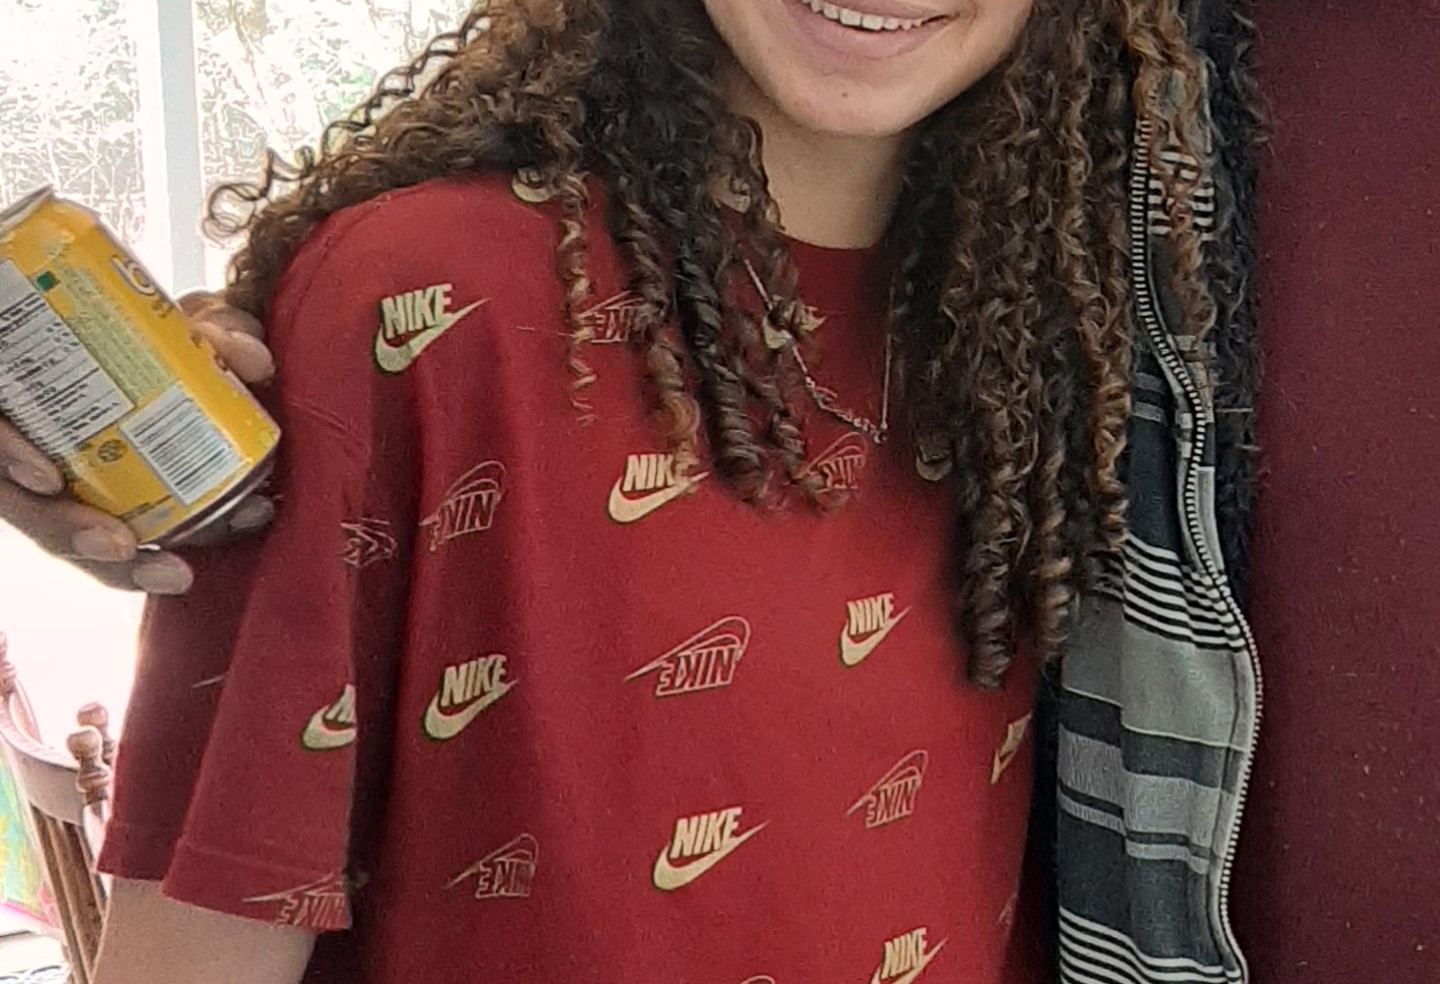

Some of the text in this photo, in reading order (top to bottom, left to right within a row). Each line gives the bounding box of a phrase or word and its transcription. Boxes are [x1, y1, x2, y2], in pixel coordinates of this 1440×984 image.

[381, 283, 452, 340] NIKE
[622, 453, 686, 492] NIK
[846, 593, 894, 636] NIKE
[440, 654, 507, 707] NIKE
[669, 807, 743, 859] NIKE
[880, 927, 928, 980] NIKE
